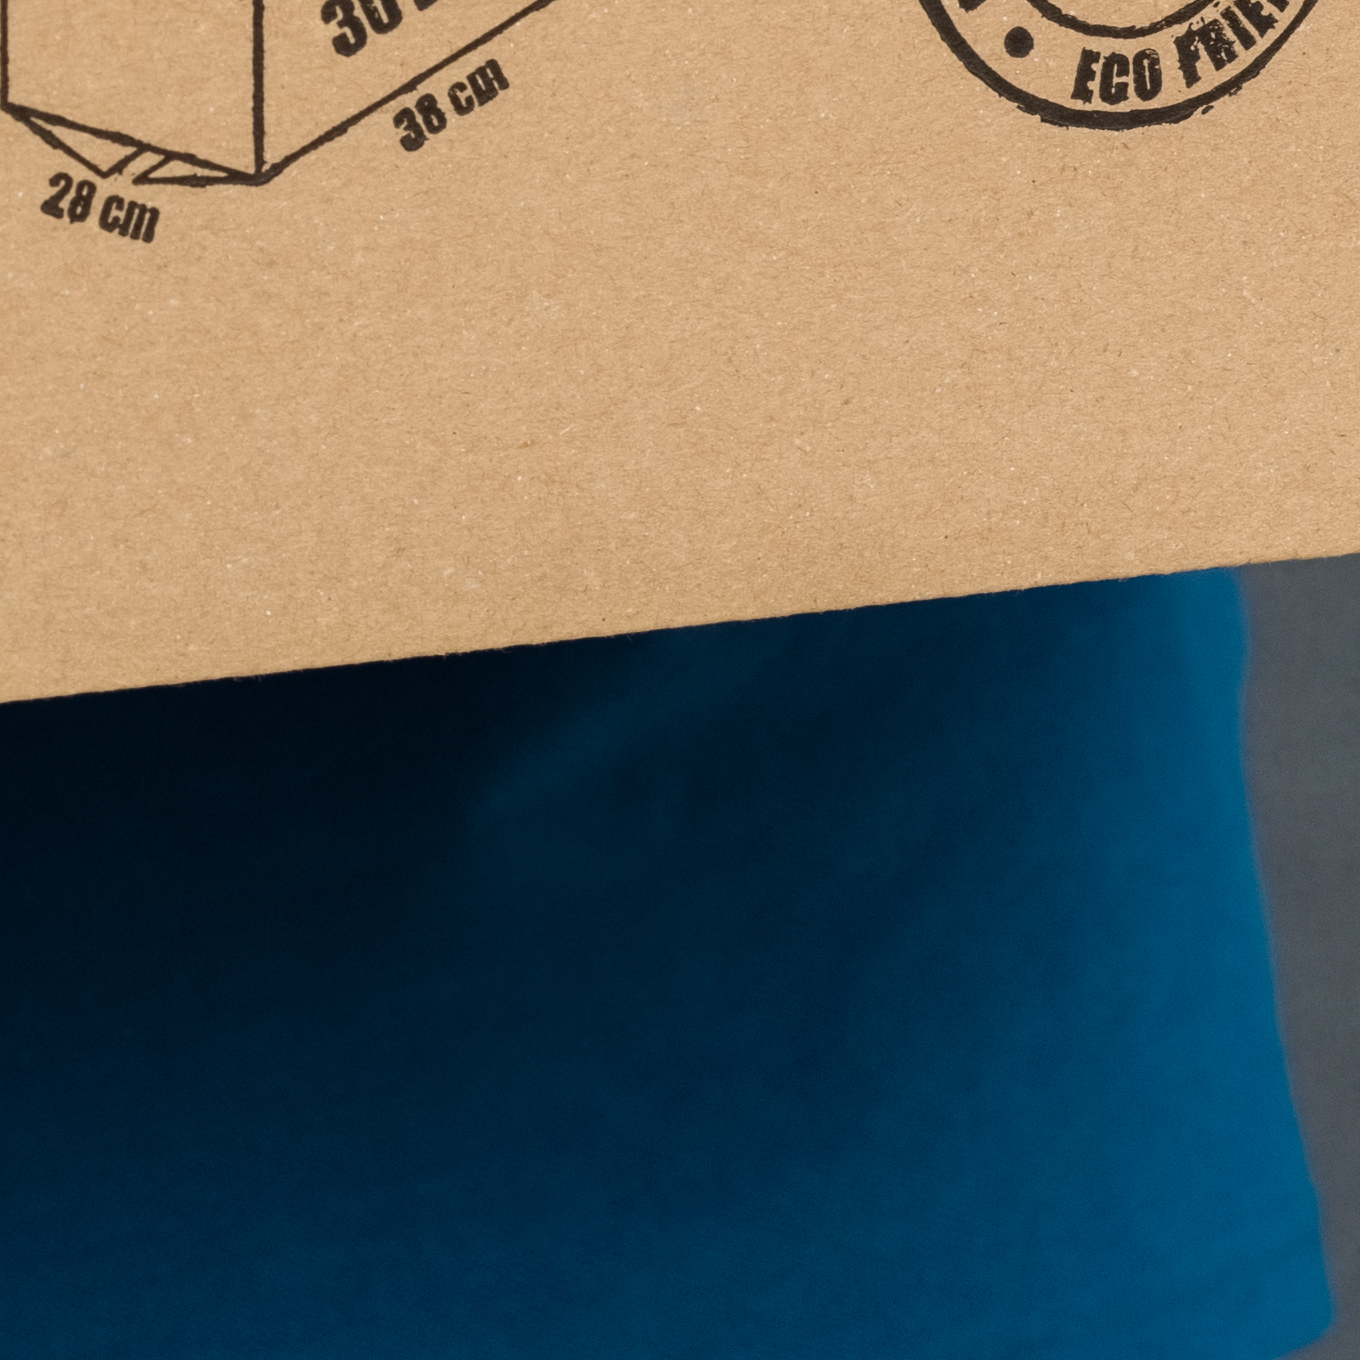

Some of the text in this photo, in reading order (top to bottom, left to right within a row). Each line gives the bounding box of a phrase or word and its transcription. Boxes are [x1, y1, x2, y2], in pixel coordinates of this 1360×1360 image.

[392, 58, 510, 152] 38 cm
[1070, 46, 1162, 106] ECO
[40, 172, 162, 244] 28 cm
